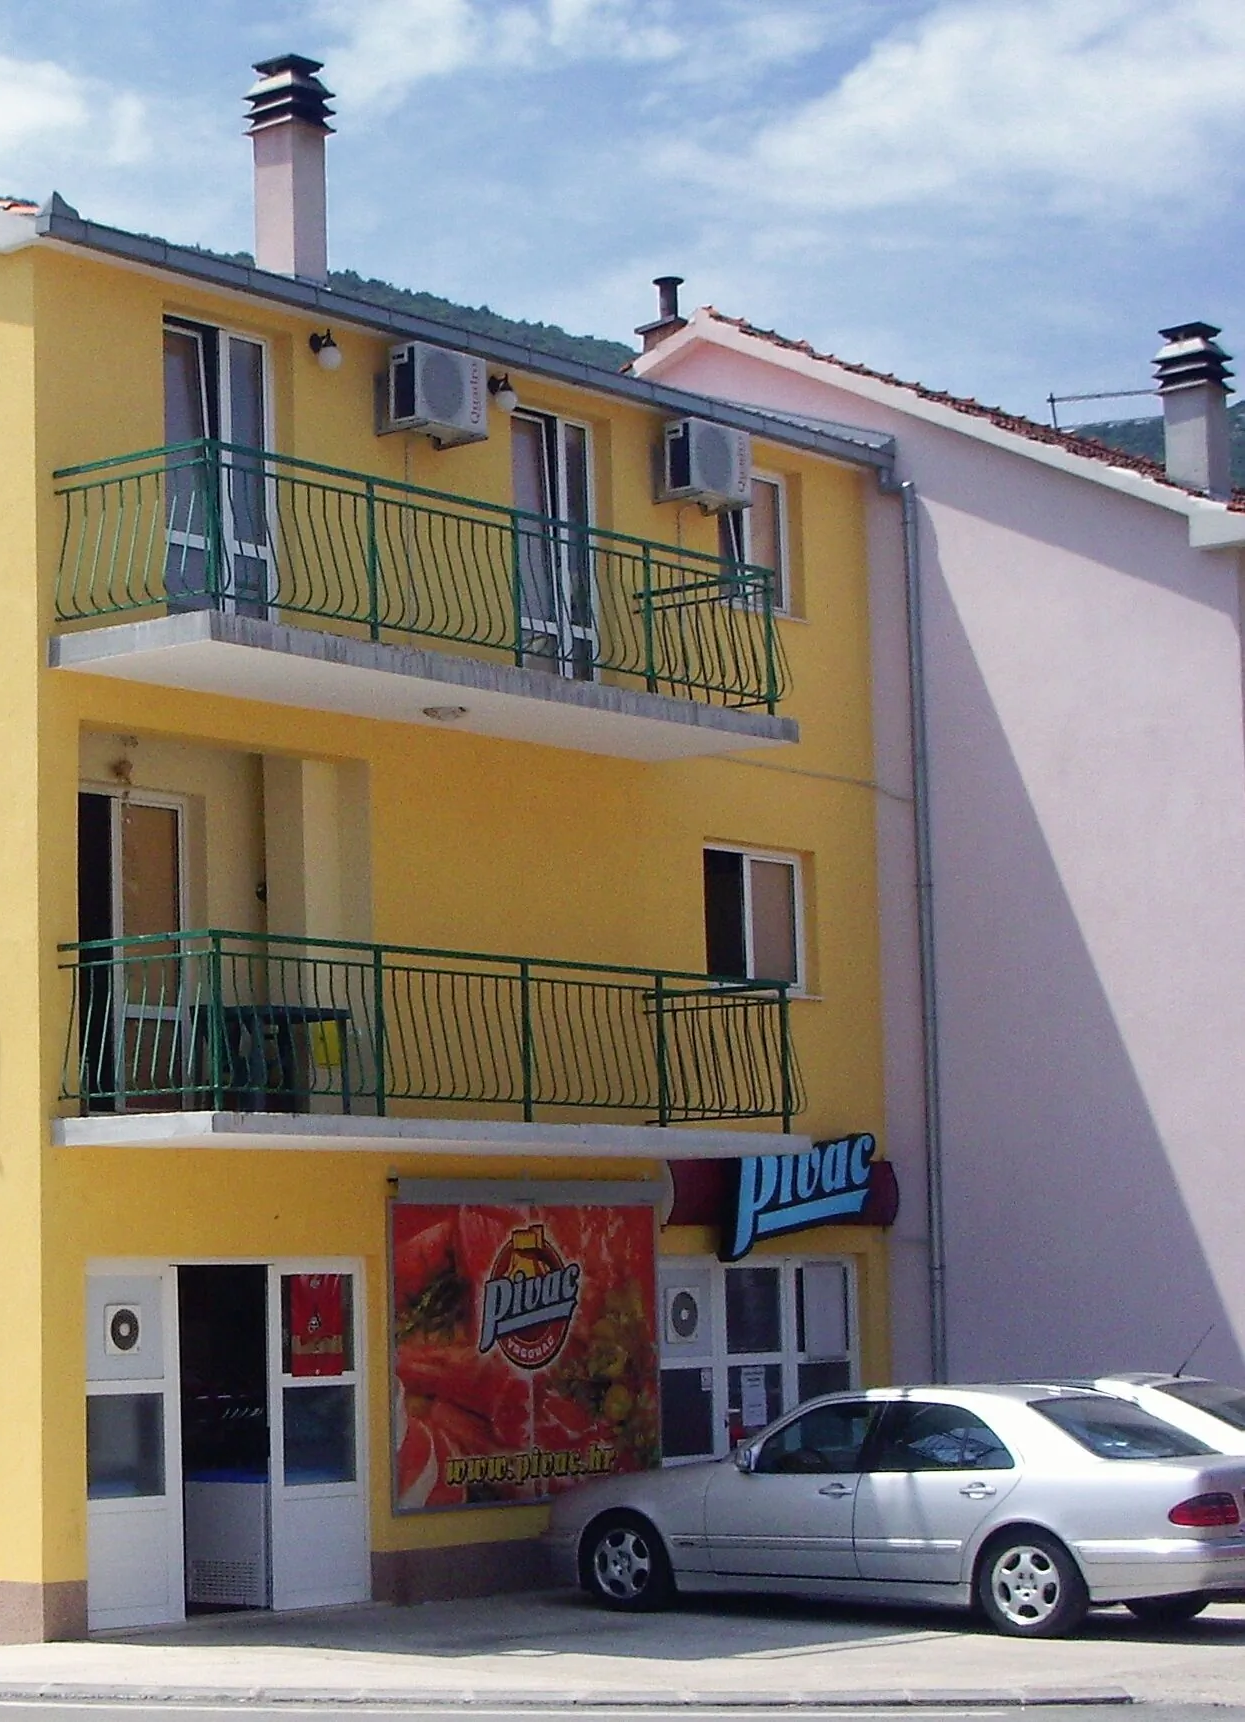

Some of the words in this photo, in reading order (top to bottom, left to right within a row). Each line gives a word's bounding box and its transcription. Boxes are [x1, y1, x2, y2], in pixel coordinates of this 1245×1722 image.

[731, 1134, 874, 1256] Pivac
[480, 1264, 580, 1353] Pivac
[445, 1441, 617, 1485] www.pivac.hr
